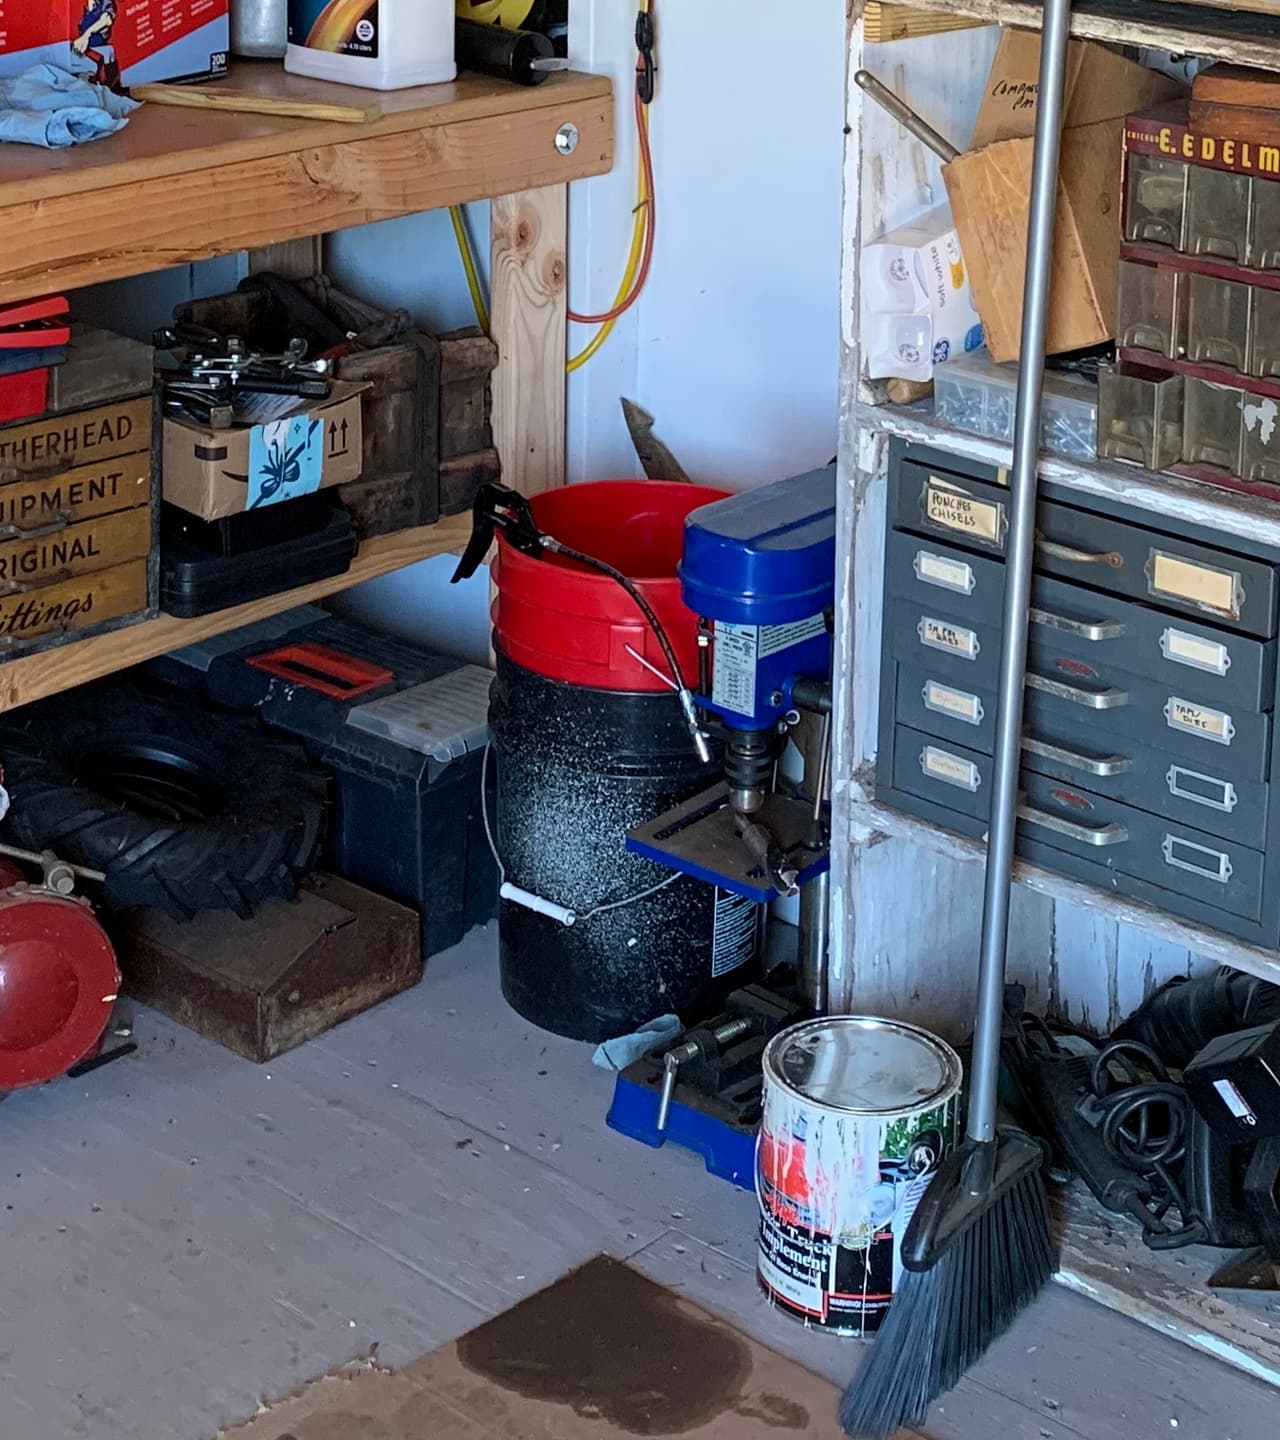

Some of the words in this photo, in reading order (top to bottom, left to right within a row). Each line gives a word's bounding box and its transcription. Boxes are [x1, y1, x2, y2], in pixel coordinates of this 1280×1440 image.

[212, 54, 226, 65] 200
[1159, 128, 1176, 154] E.
[931, 246, 944, 276] white
[931, 507, 976, 527] CHISELS
[762, 1220, 828, 1273] Implement
